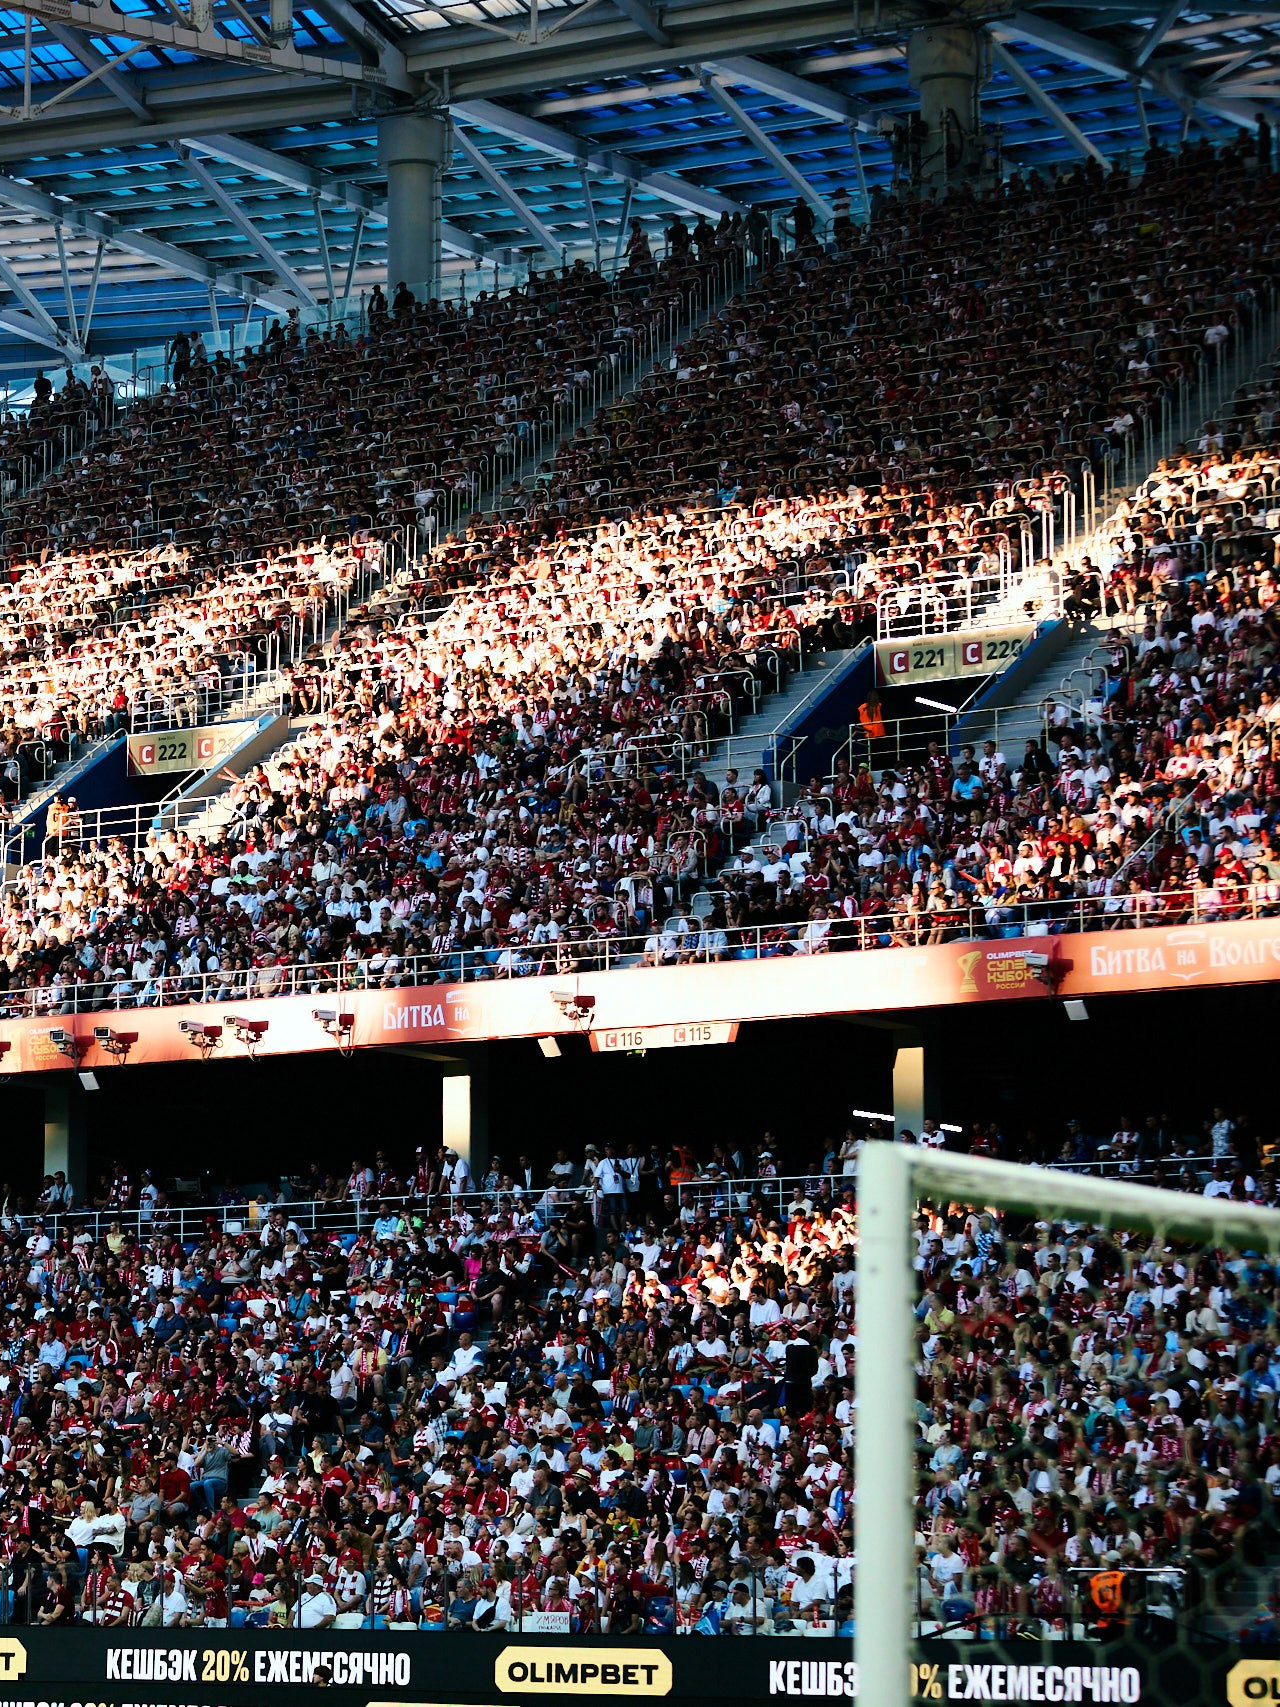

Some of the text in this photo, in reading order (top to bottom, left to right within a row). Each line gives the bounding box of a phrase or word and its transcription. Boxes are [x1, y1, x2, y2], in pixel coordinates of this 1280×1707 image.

[893, 649, 944, 672] C 221
[141, 743, 187, 763] C 222
[987, 959, 1027, 971] СУПЕ
[987, 970, 1033, 983] КУБОК
[996, 982, 1025, 990] РОССИИ
[620, 1032, 643, 1046] 116
[688, 1026, 711, 1042] 115
[106, 1648, 198, 1682] КЕШБЭК
[201, 1649, 250, 1682] 20%
[507, 1661, 659, 1685] OLIMPBET
[769, 1660, 858, 1697] КЕШБЭ
[947, 1663, 1141, 1704] ЕЖЕМЕСЯЧНО
